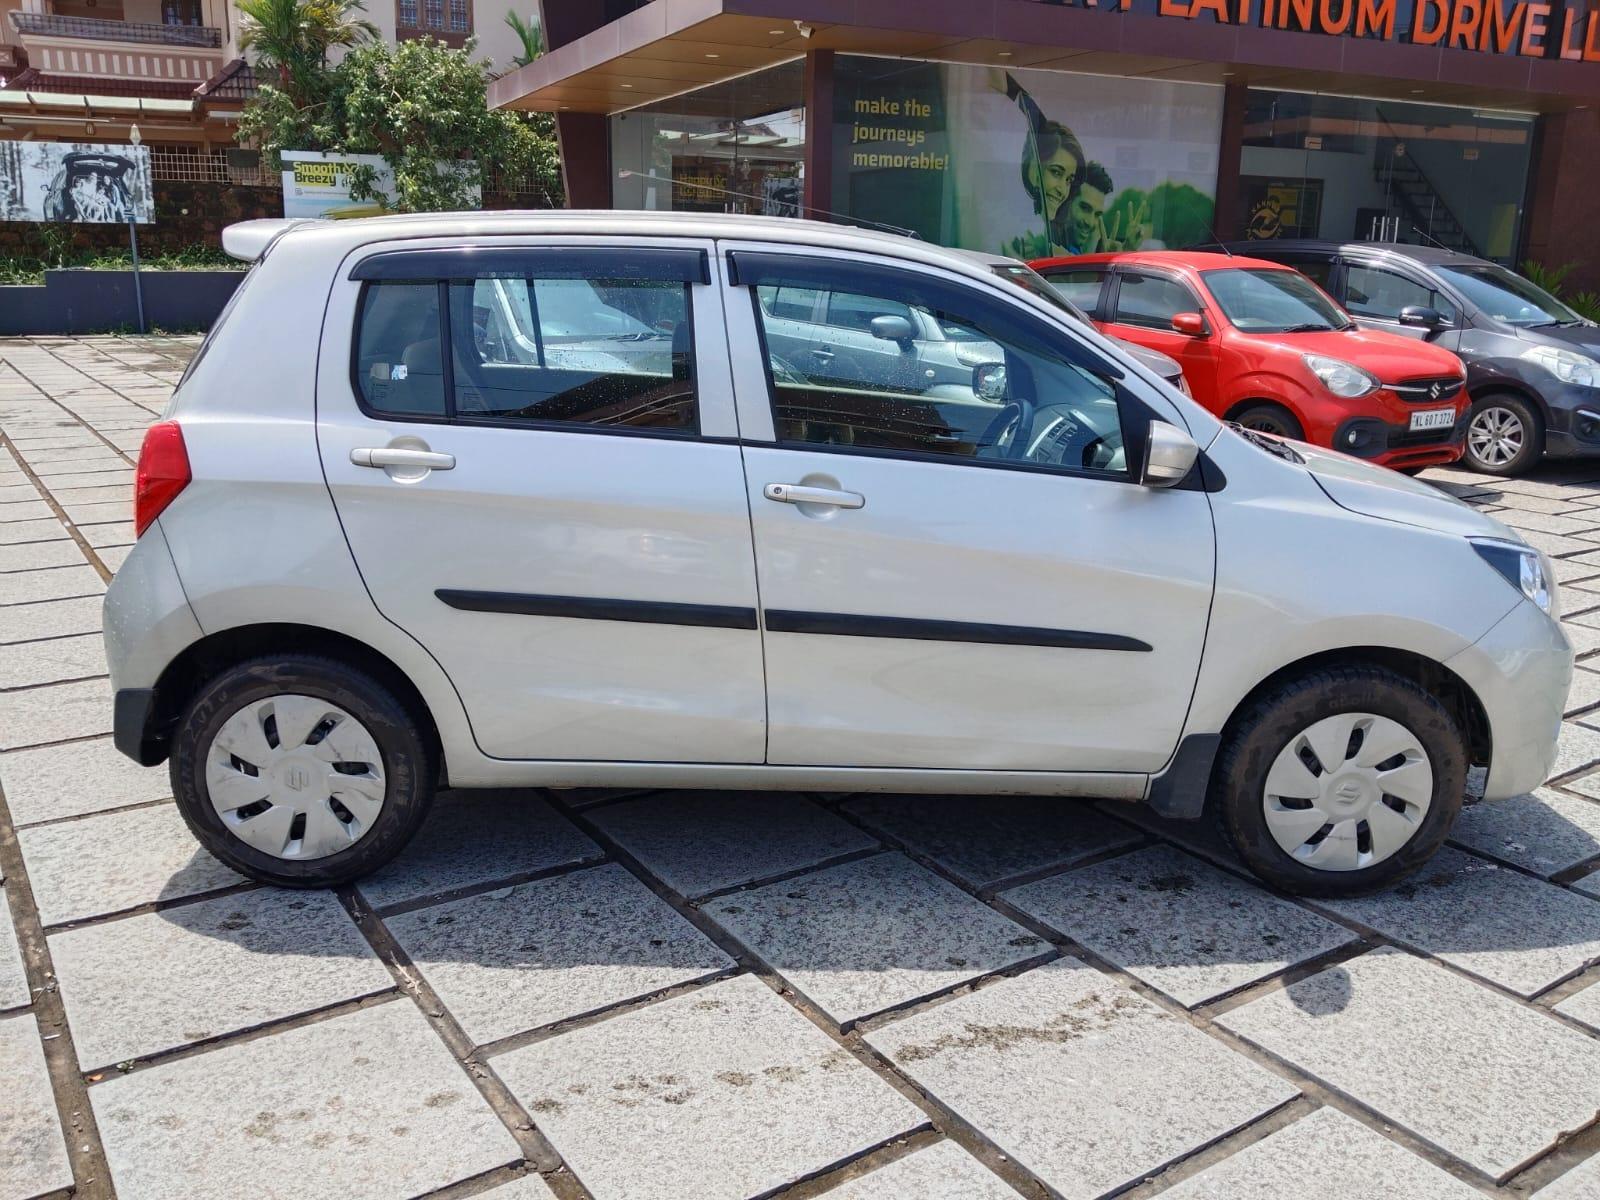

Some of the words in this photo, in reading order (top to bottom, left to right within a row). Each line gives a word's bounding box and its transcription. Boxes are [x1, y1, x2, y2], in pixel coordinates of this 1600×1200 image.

[1121, 0, 1398, 40] INUM
[1413, 0, 1550, 57] DRIVE
[855, 96, 900, 115] make
[904, 98, 931, 117] the
[852, 121, 925, 147] journeys
[293, 161, 341, 174] Smooth
[853, 151, 949, 170] memorable!
[295, 172, 336, 187] Breezy
